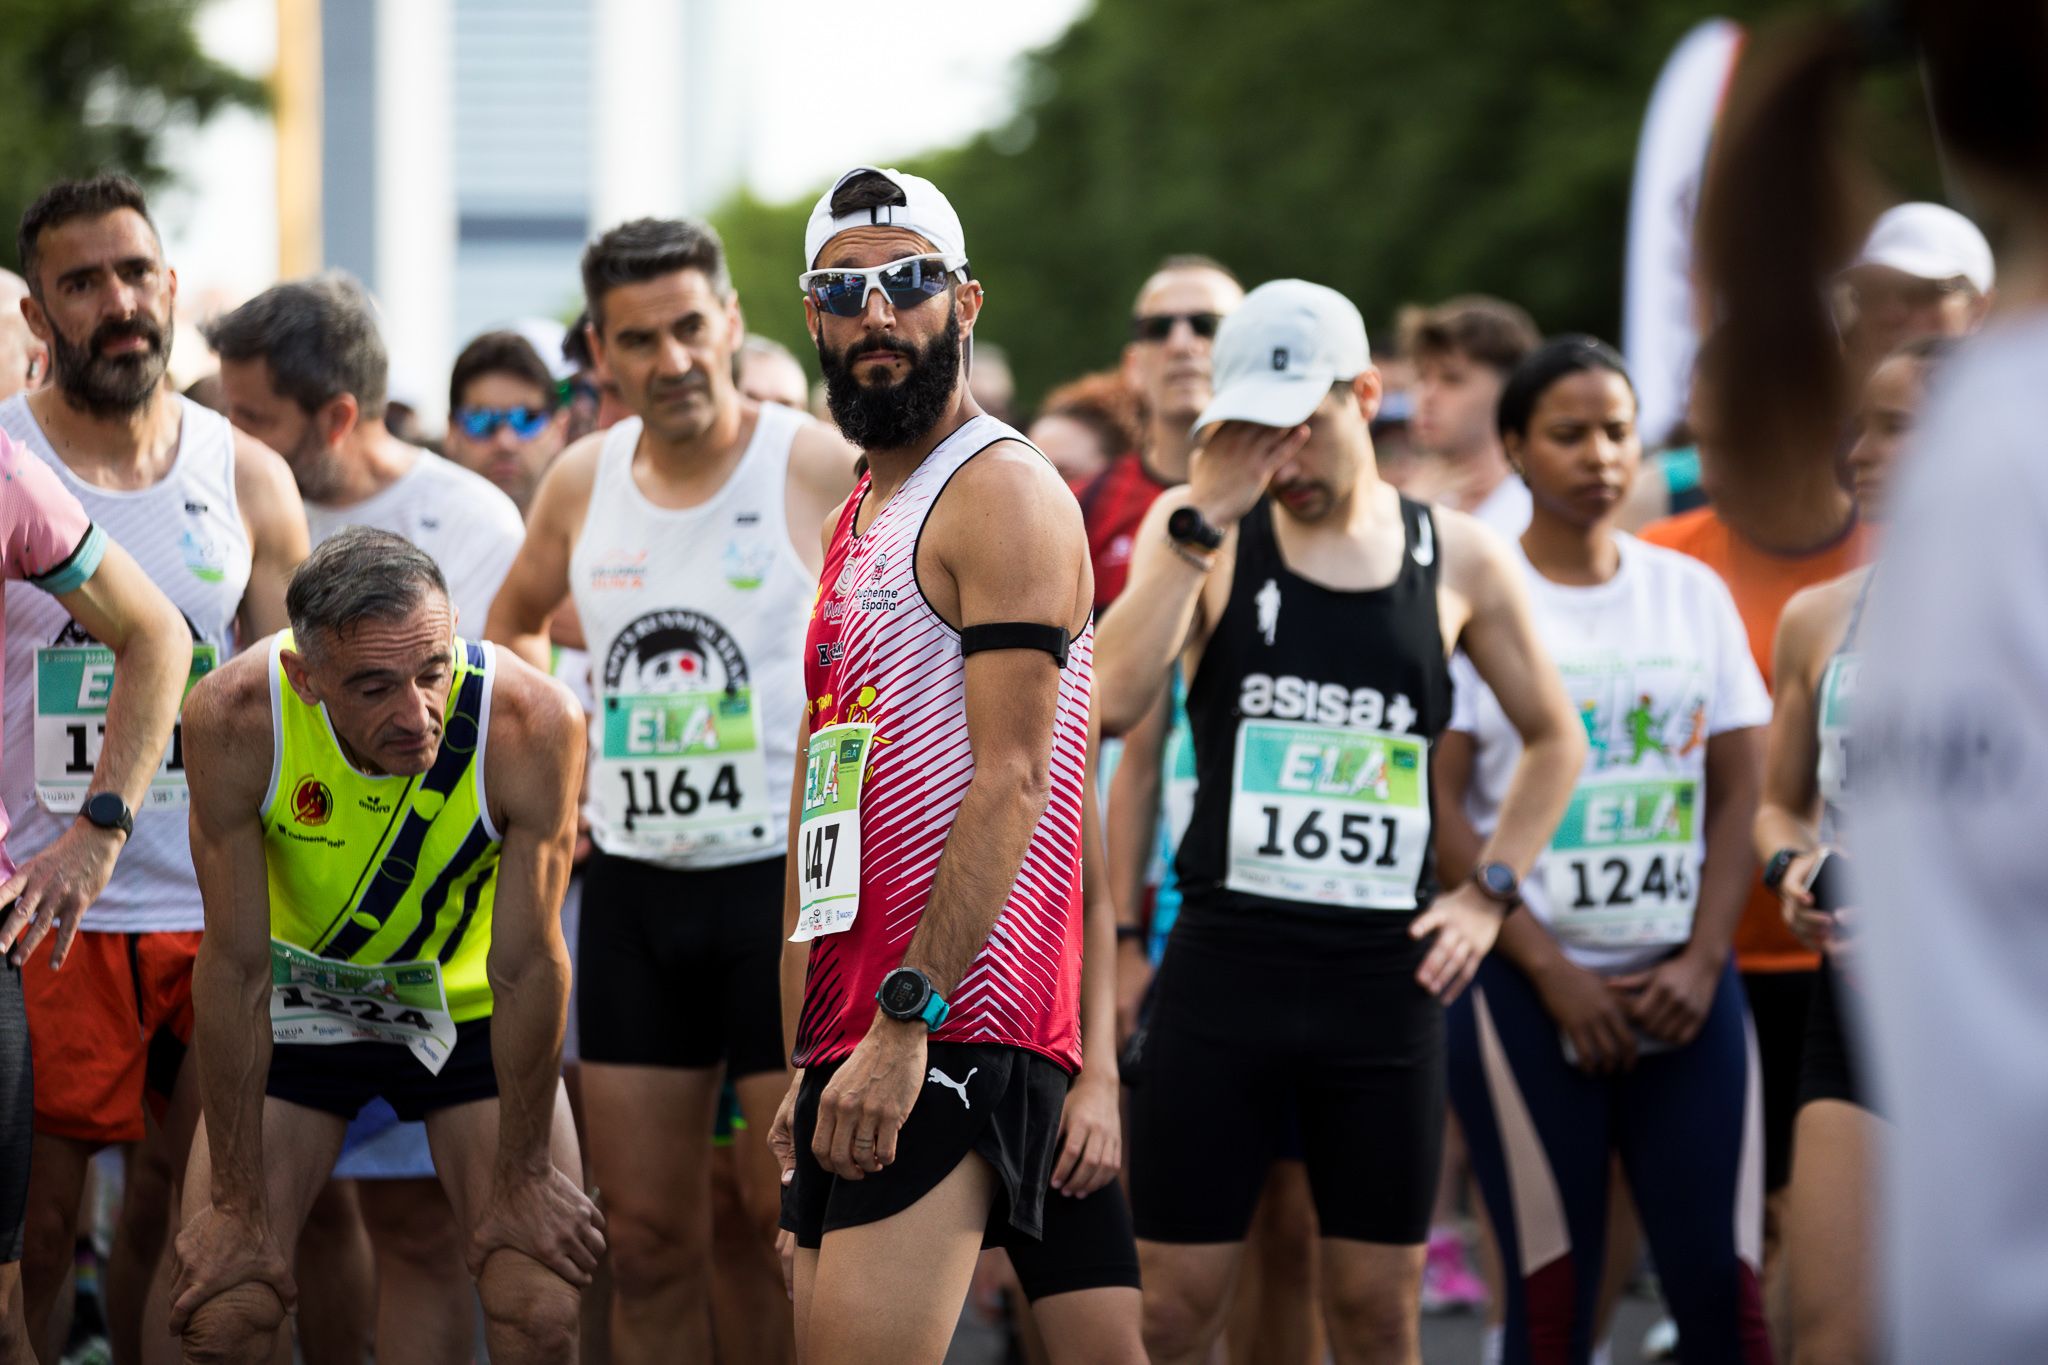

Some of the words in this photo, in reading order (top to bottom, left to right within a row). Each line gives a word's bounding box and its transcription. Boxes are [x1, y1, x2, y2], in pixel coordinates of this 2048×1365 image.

[861, 599, 896, 611] España
[627, 703, 719, 753] ELA
[1239, 673, 1386, 730] asisa
[620, 763, 743, 816] 1164
[1278, 743, 1390, 800] ELA
[1257, 805, 1398, 867] 1651
[1584, 789, 1682, 842] ELA
[276, 986, 434, 1031] 1224
